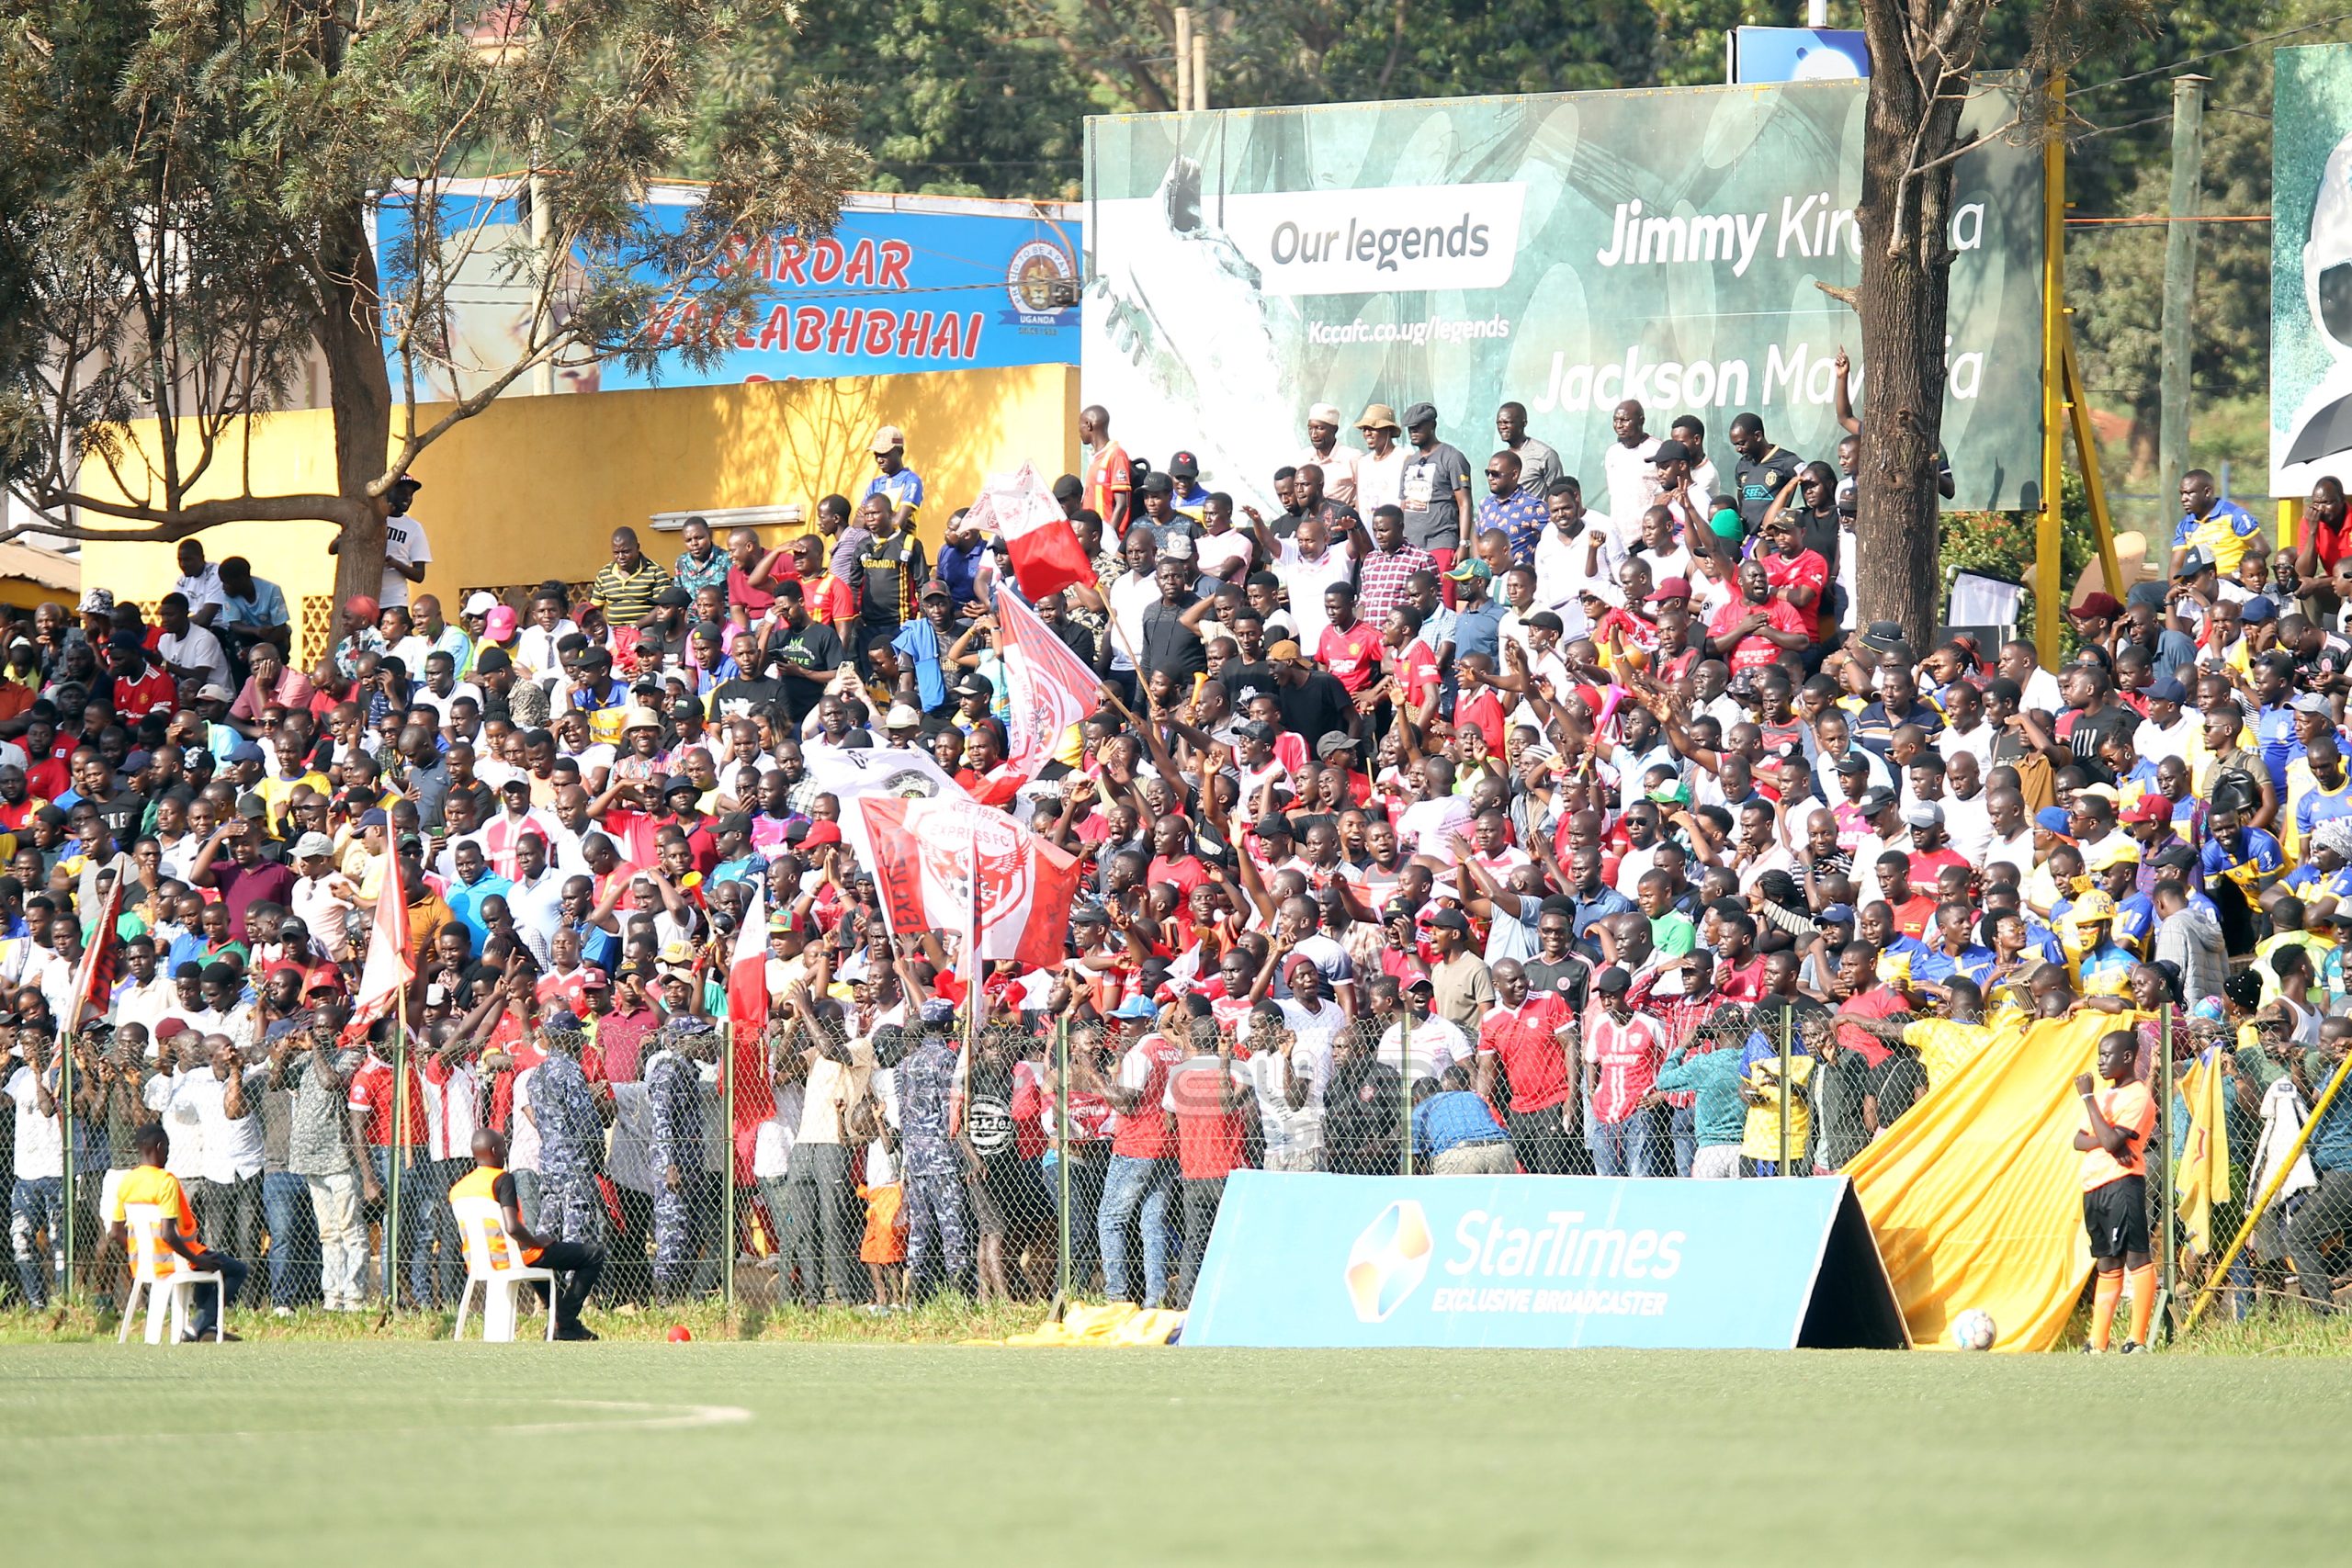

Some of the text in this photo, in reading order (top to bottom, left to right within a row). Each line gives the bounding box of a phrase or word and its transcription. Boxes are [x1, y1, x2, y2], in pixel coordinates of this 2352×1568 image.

[1271, 212, 1489, 272] Our legends
[1596, 191, 1985, 277] Jimmy Kira
[1019, 314, 1056, 324] UGANDA
[1308, 313, 1510, 346] Kccafc.co.ug/legends
[1534, 344, 1748, 413] Jackson
[387, 526, 407, 544] MA
[862, 558, 898, 570] UGANDA
[1736, 649, 1776, 659] EXPRESS
[977, 807, 1001, 822] 1957
[992, 832, 1010, 848] FC
[2087, 895, 2114, 906] KCCA
[1991, 998, 2020, 1010] CHN
[1444, 1209, 1687, 1280] StarTimes
[1431, 1287, 1668, 1316] EXCLUSIVE BROADCASTER
